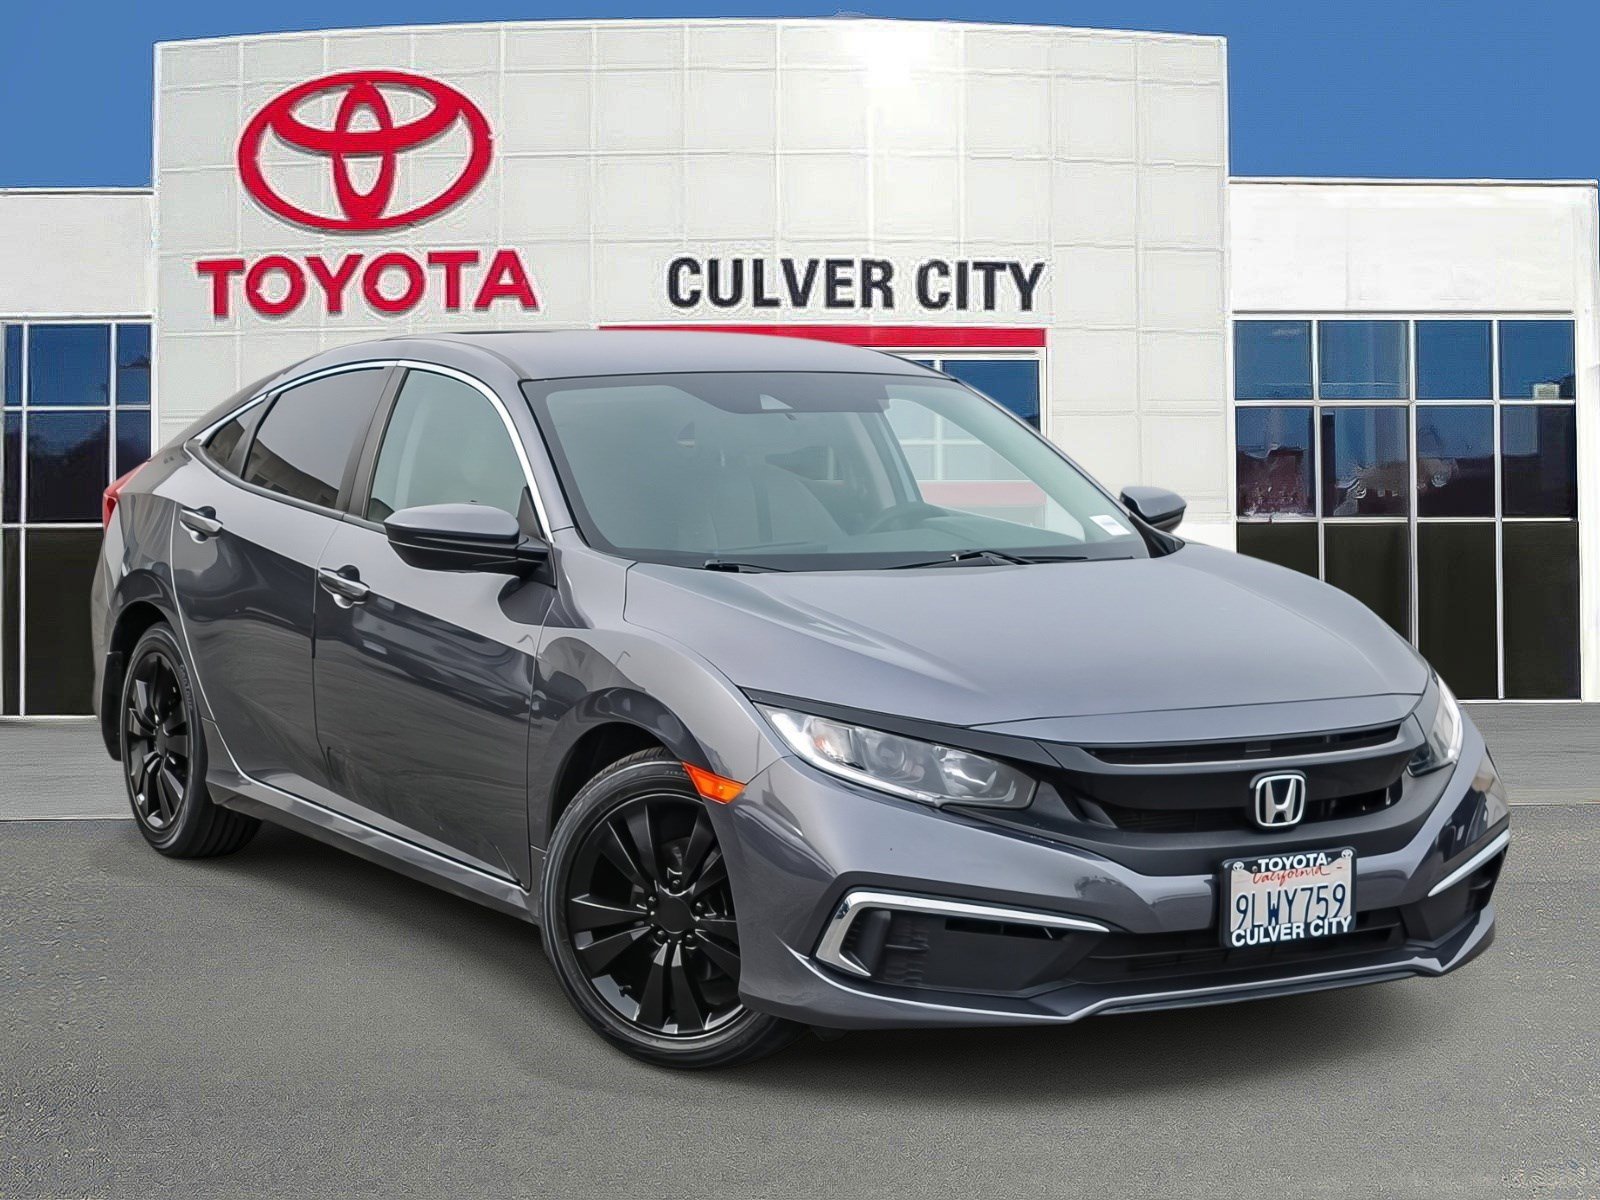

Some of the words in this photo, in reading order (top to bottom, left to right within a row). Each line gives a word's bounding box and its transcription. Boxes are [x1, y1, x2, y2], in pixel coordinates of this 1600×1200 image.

[195, 249, 539, 319] TOYOTA
[668, 258, 895, 309] CULVER
[916, 260, 1045, 311] CITY
[1252, 866, 1330, 886] California
[1258, 852, 1327, 872] TOYOTA
[1236, 883, 1346, 929] 9LWY759
[1232, 922, 1305, 947] CULVER
[1310, 915, 1352, 937] CITY
